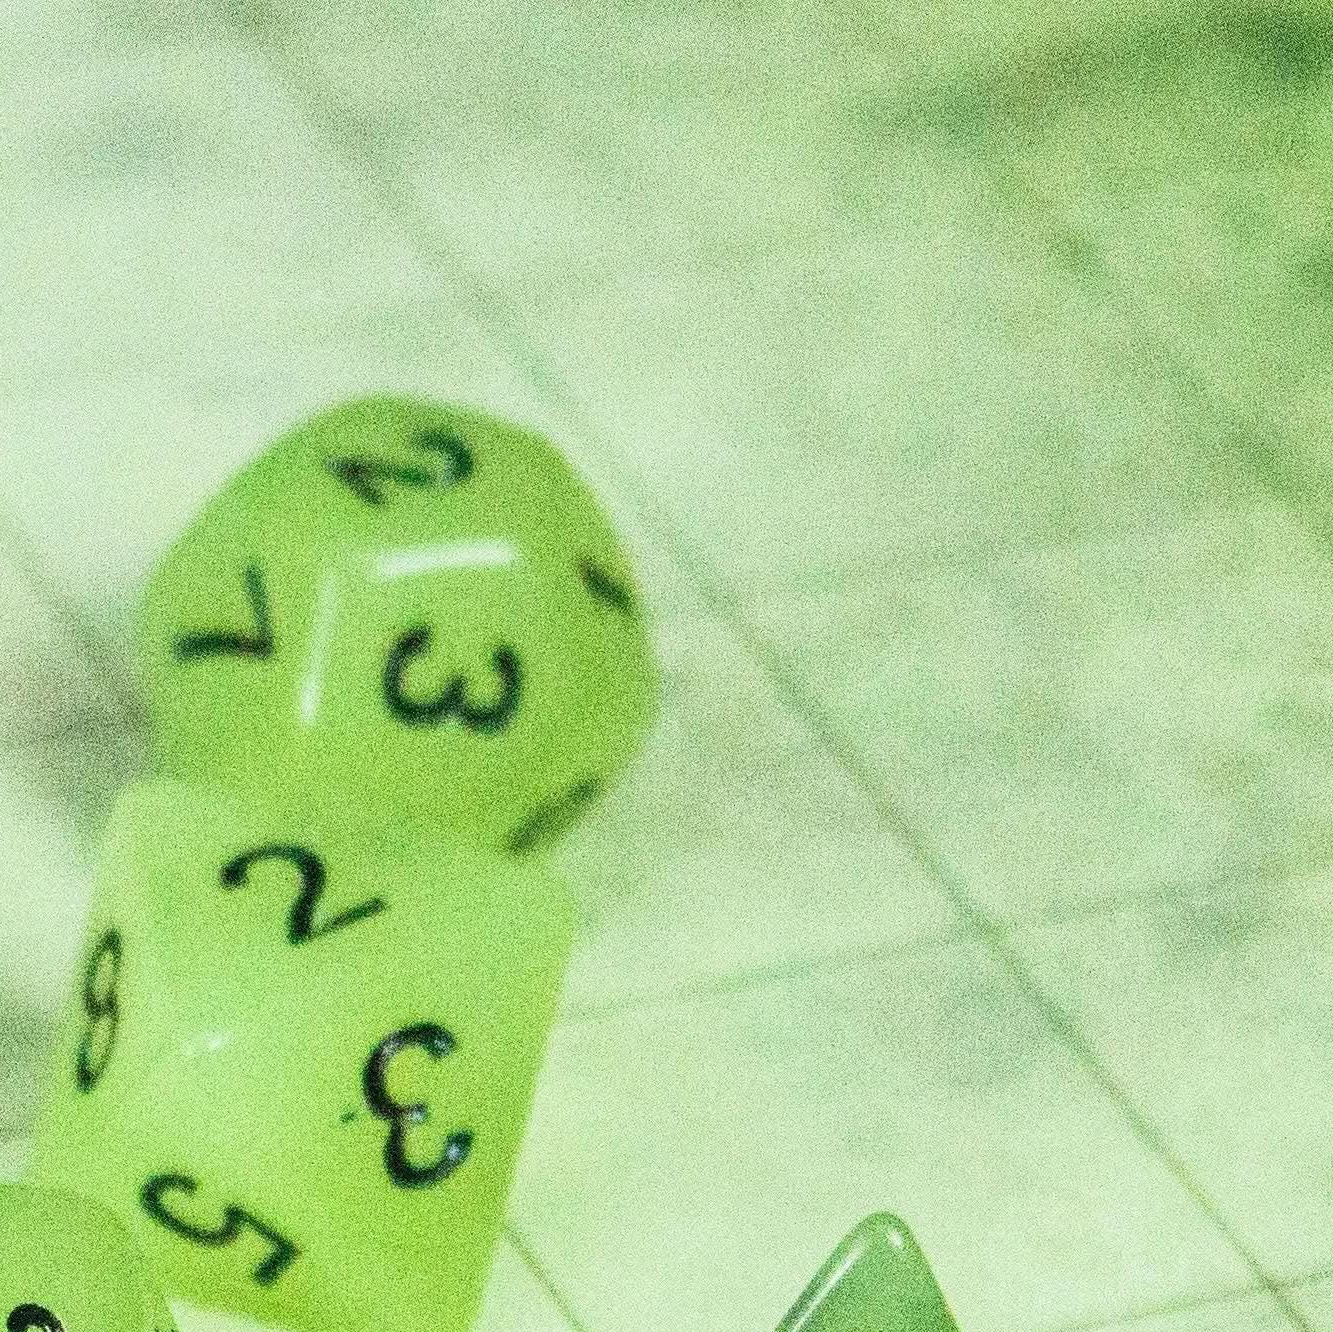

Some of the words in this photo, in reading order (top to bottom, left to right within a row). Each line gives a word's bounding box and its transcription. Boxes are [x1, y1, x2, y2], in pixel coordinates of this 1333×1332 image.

[326, 427, 476, 507] 2
[174, 570, 275, 661] 7
[382, 626, 524, 734] 3
[220, 842, 390, 946] 2
[74, 929, 122, 1093] 8
[362, 1022, 473, 1189] 3
[140, 1172, 300, 1288] 5
